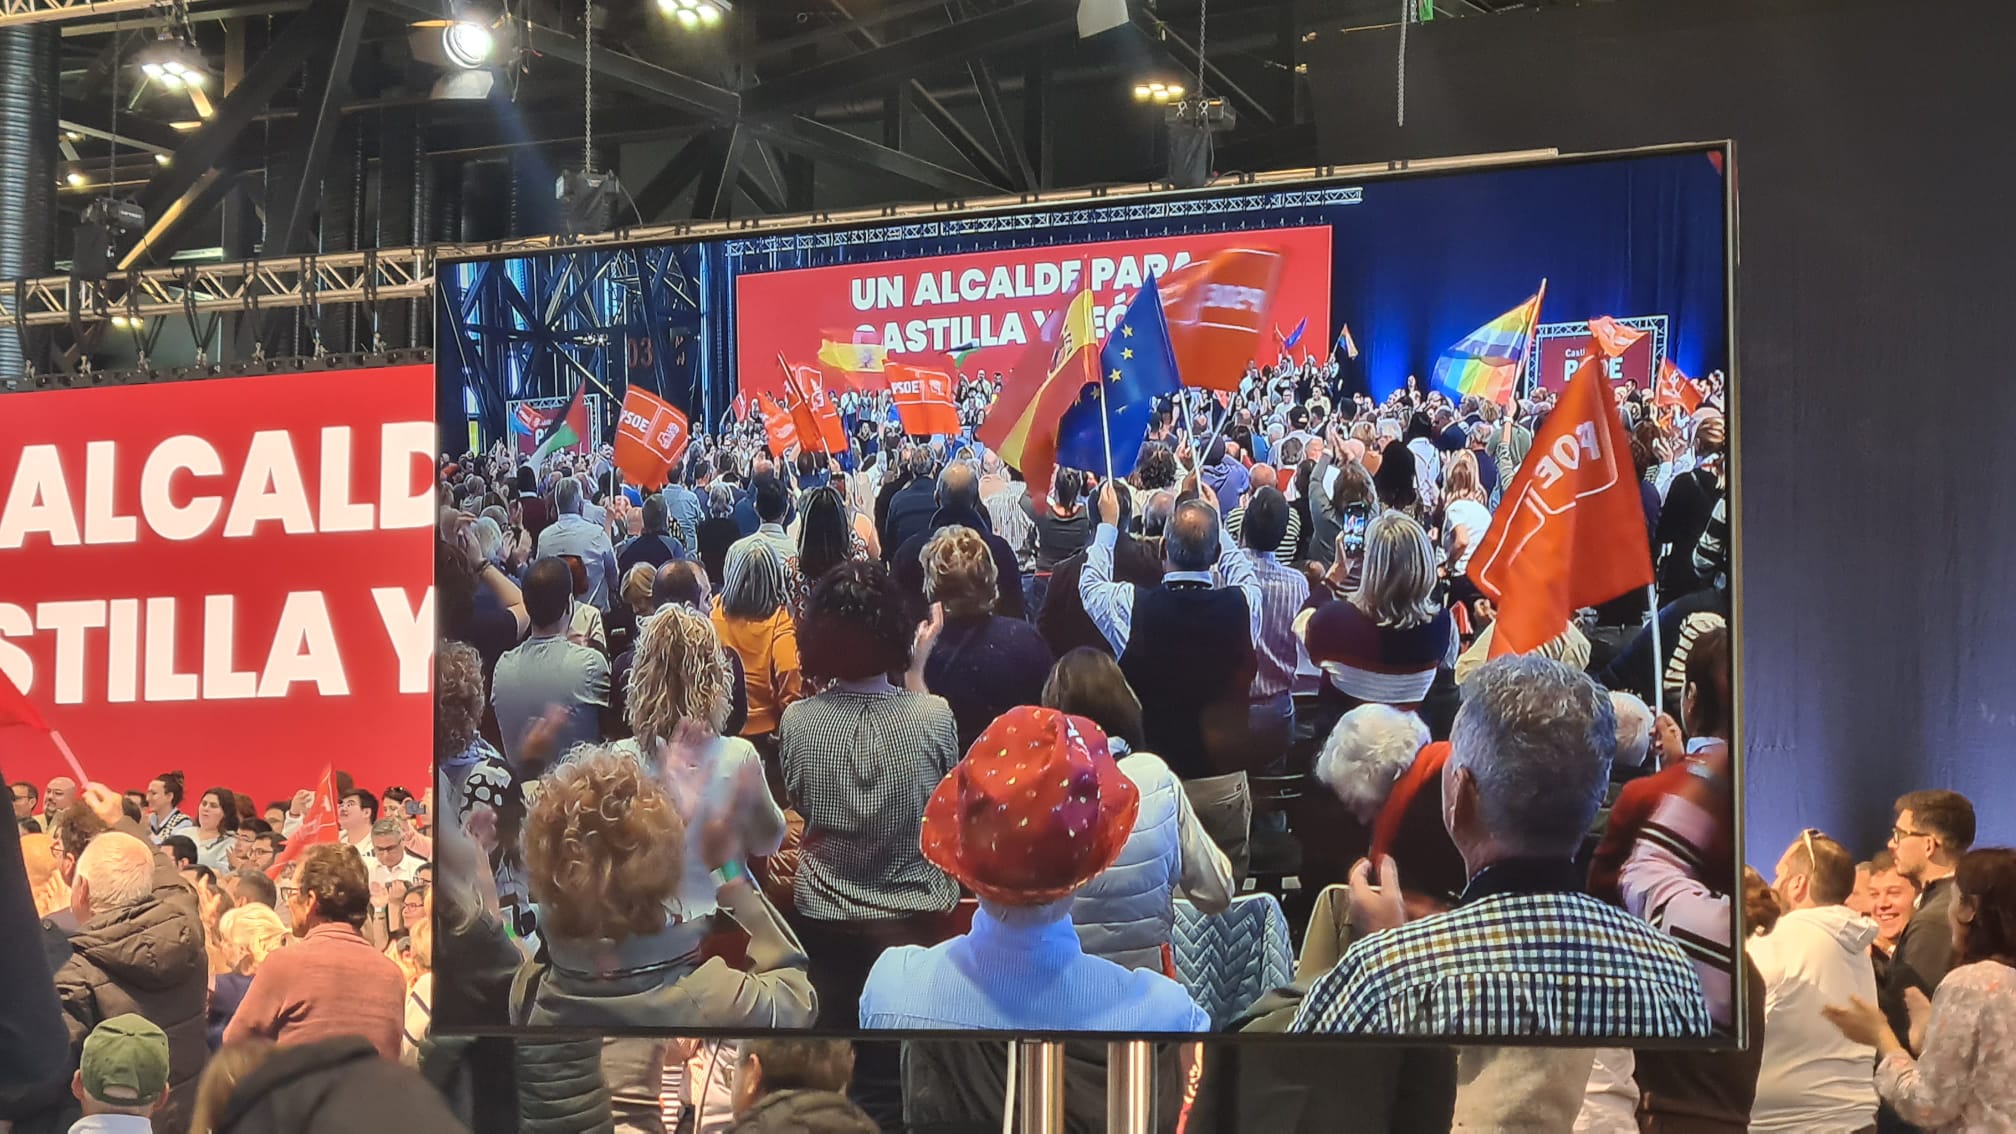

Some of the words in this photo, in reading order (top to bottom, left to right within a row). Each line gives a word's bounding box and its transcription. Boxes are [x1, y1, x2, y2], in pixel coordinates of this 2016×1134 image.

[851, 275, 904, 311] UN
[890, 380, 920, 395] PSOE
[371, 586, 437, 694] Y
